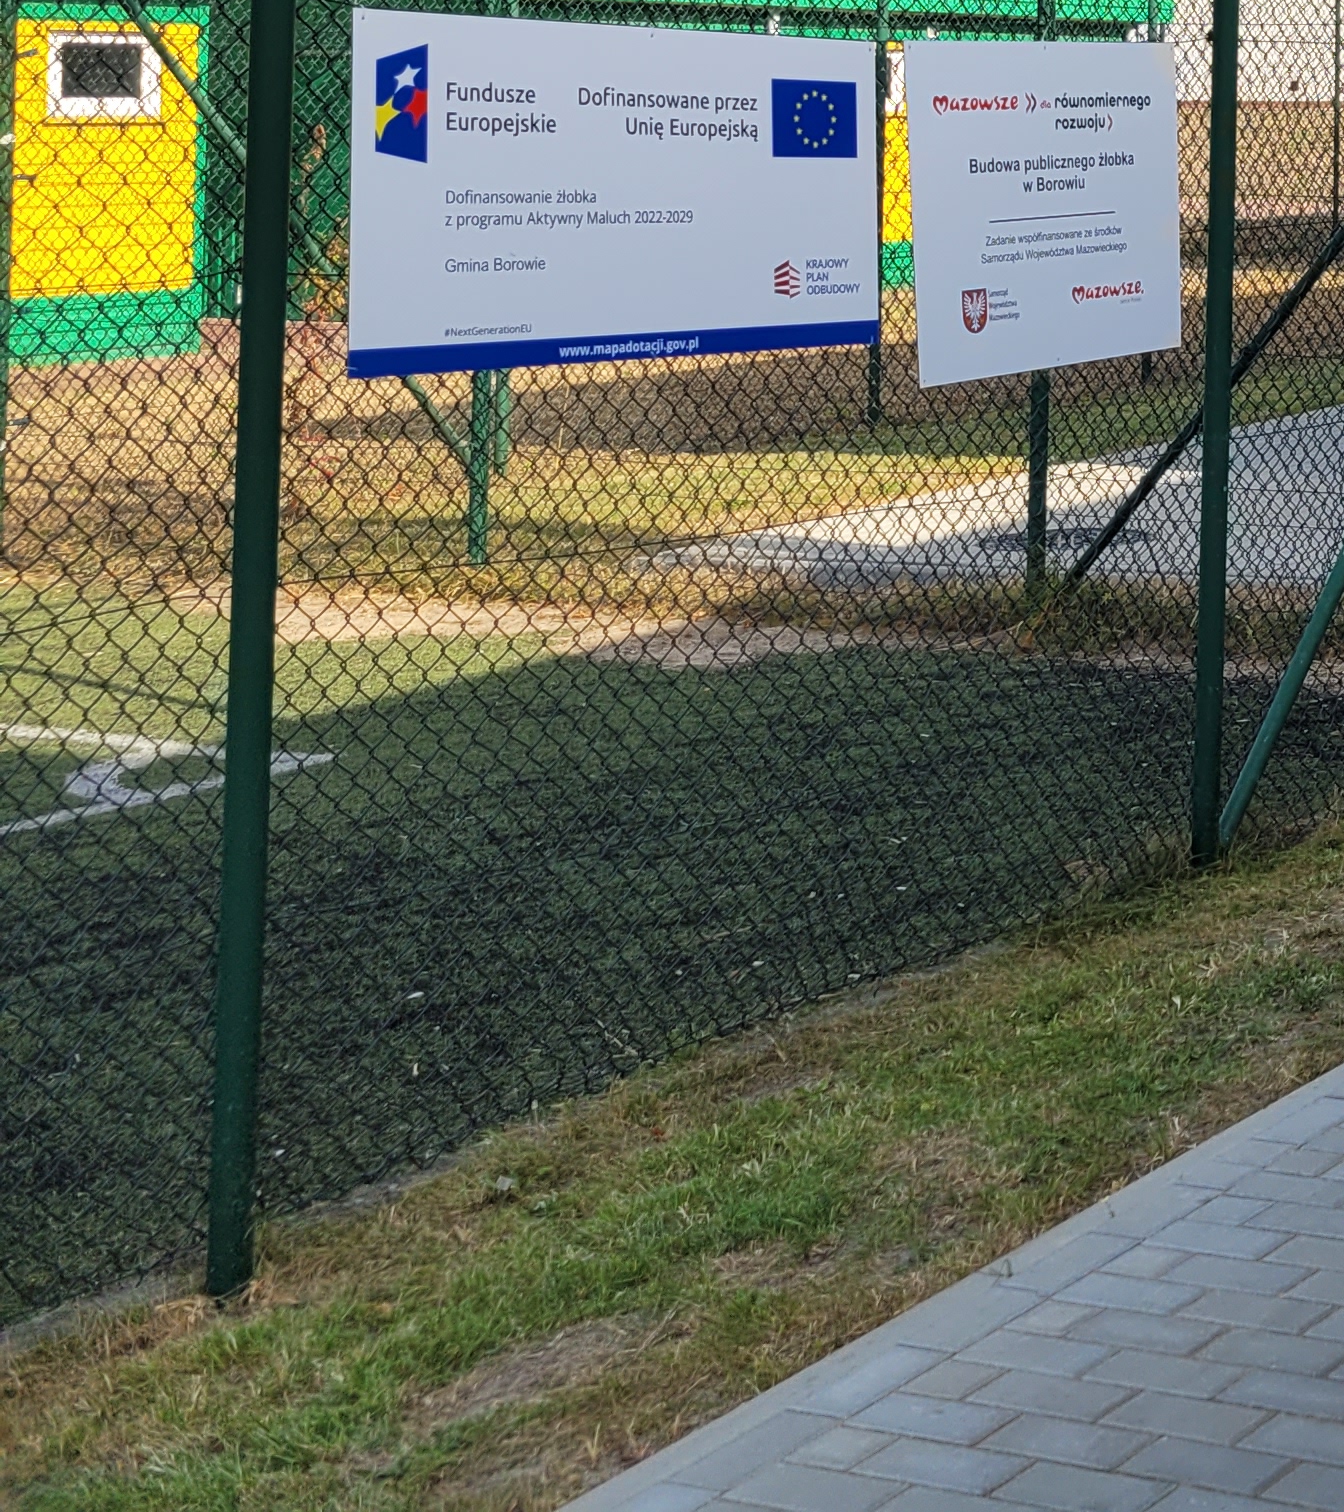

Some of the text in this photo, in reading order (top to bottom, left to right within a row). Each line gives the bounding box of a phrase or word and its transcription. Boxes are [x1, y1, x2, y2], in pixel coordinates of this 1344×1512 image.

[446, 81, 536, 104] Fundusze
[578, 86, 758, 115] Dofinansowane przez
[1039, 99, 1052, 110] dla
[1054, 91, 1151, 111] równomiernego
[446, 111, 557, 137] Europejskie
[625, 116, 759, 143] Unię Europejską
[1054, 113, 1106, 133] rozwoju
[969, 151, 1135, 174] Budowa publicznego żłobka
[1022, 175, 1086, 193] w Borowiu
[445, 188, 597, 205] Dofinansowanie żłobka
[444, 209, 694, 231] z programu Aktywny Maluch 2022-2029
[985, 235, 1017, 247] Zadanie
[1083, 229, 1093, 239] ze
[1094, 225, 1123, 238] środków
[980, 241, 1128, 265] Samorządu Województwa Mazowieckiego
[444, 256, 546, 273] Gmina Borowie
[805, 258, 850, 270] KRAJOWY
[805, 271, 830, 283] PLAN
[806, 282, 861, 296] ODBUDOWY
[444, 323, 532, 337] #NextGenerationEU
[558, 336, 700, 358] www.mapadotacji.gov.pl
